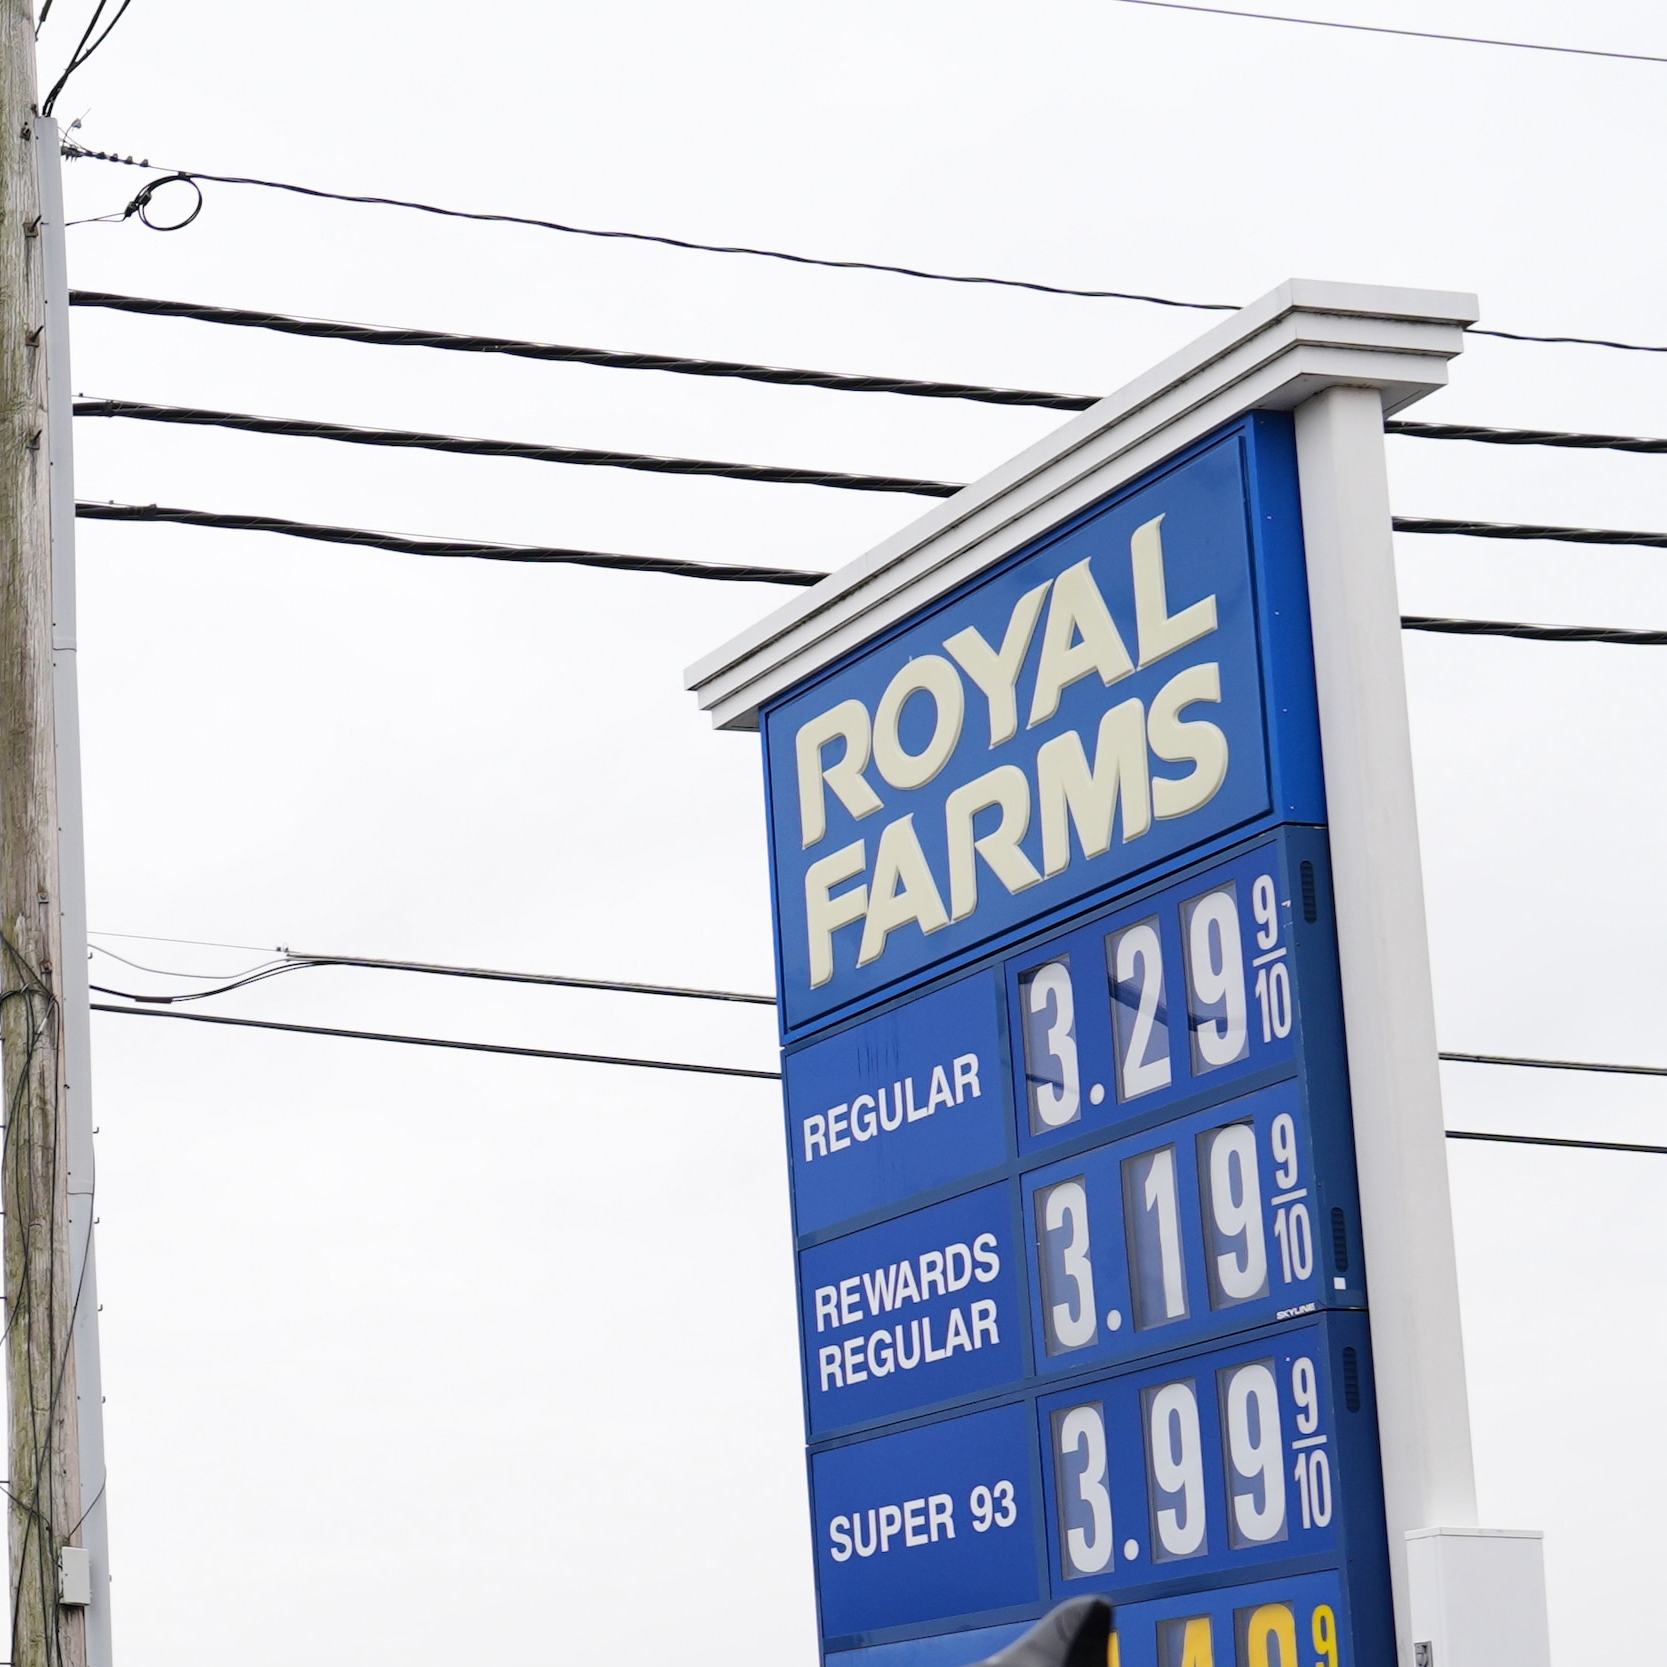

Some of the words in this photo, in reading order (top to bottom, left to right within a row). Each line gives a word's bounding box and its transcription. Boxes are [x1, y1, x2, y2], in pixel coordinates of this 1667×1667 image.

[794, 511, 1218, 852] ROYAL
[803, 661, 1230, 991] FARMS
[1029, 891, 1248, 1127] 3.29
[803, 1053, 981, 1162] REGULAR
[814, 1233, 1002, 1332] REWARDS
[1043, 1123, 1269, 1349] 3.19
[1276, 1302, 1316, 1320] SKYLINE
[818, 1299, 1000, 1392] REGULAR
[829, 1492, 957, 1563] SUPER
[969, 1480, 1018, 1535] 93
[1061, 1363, 1287, 1575] 3.99
